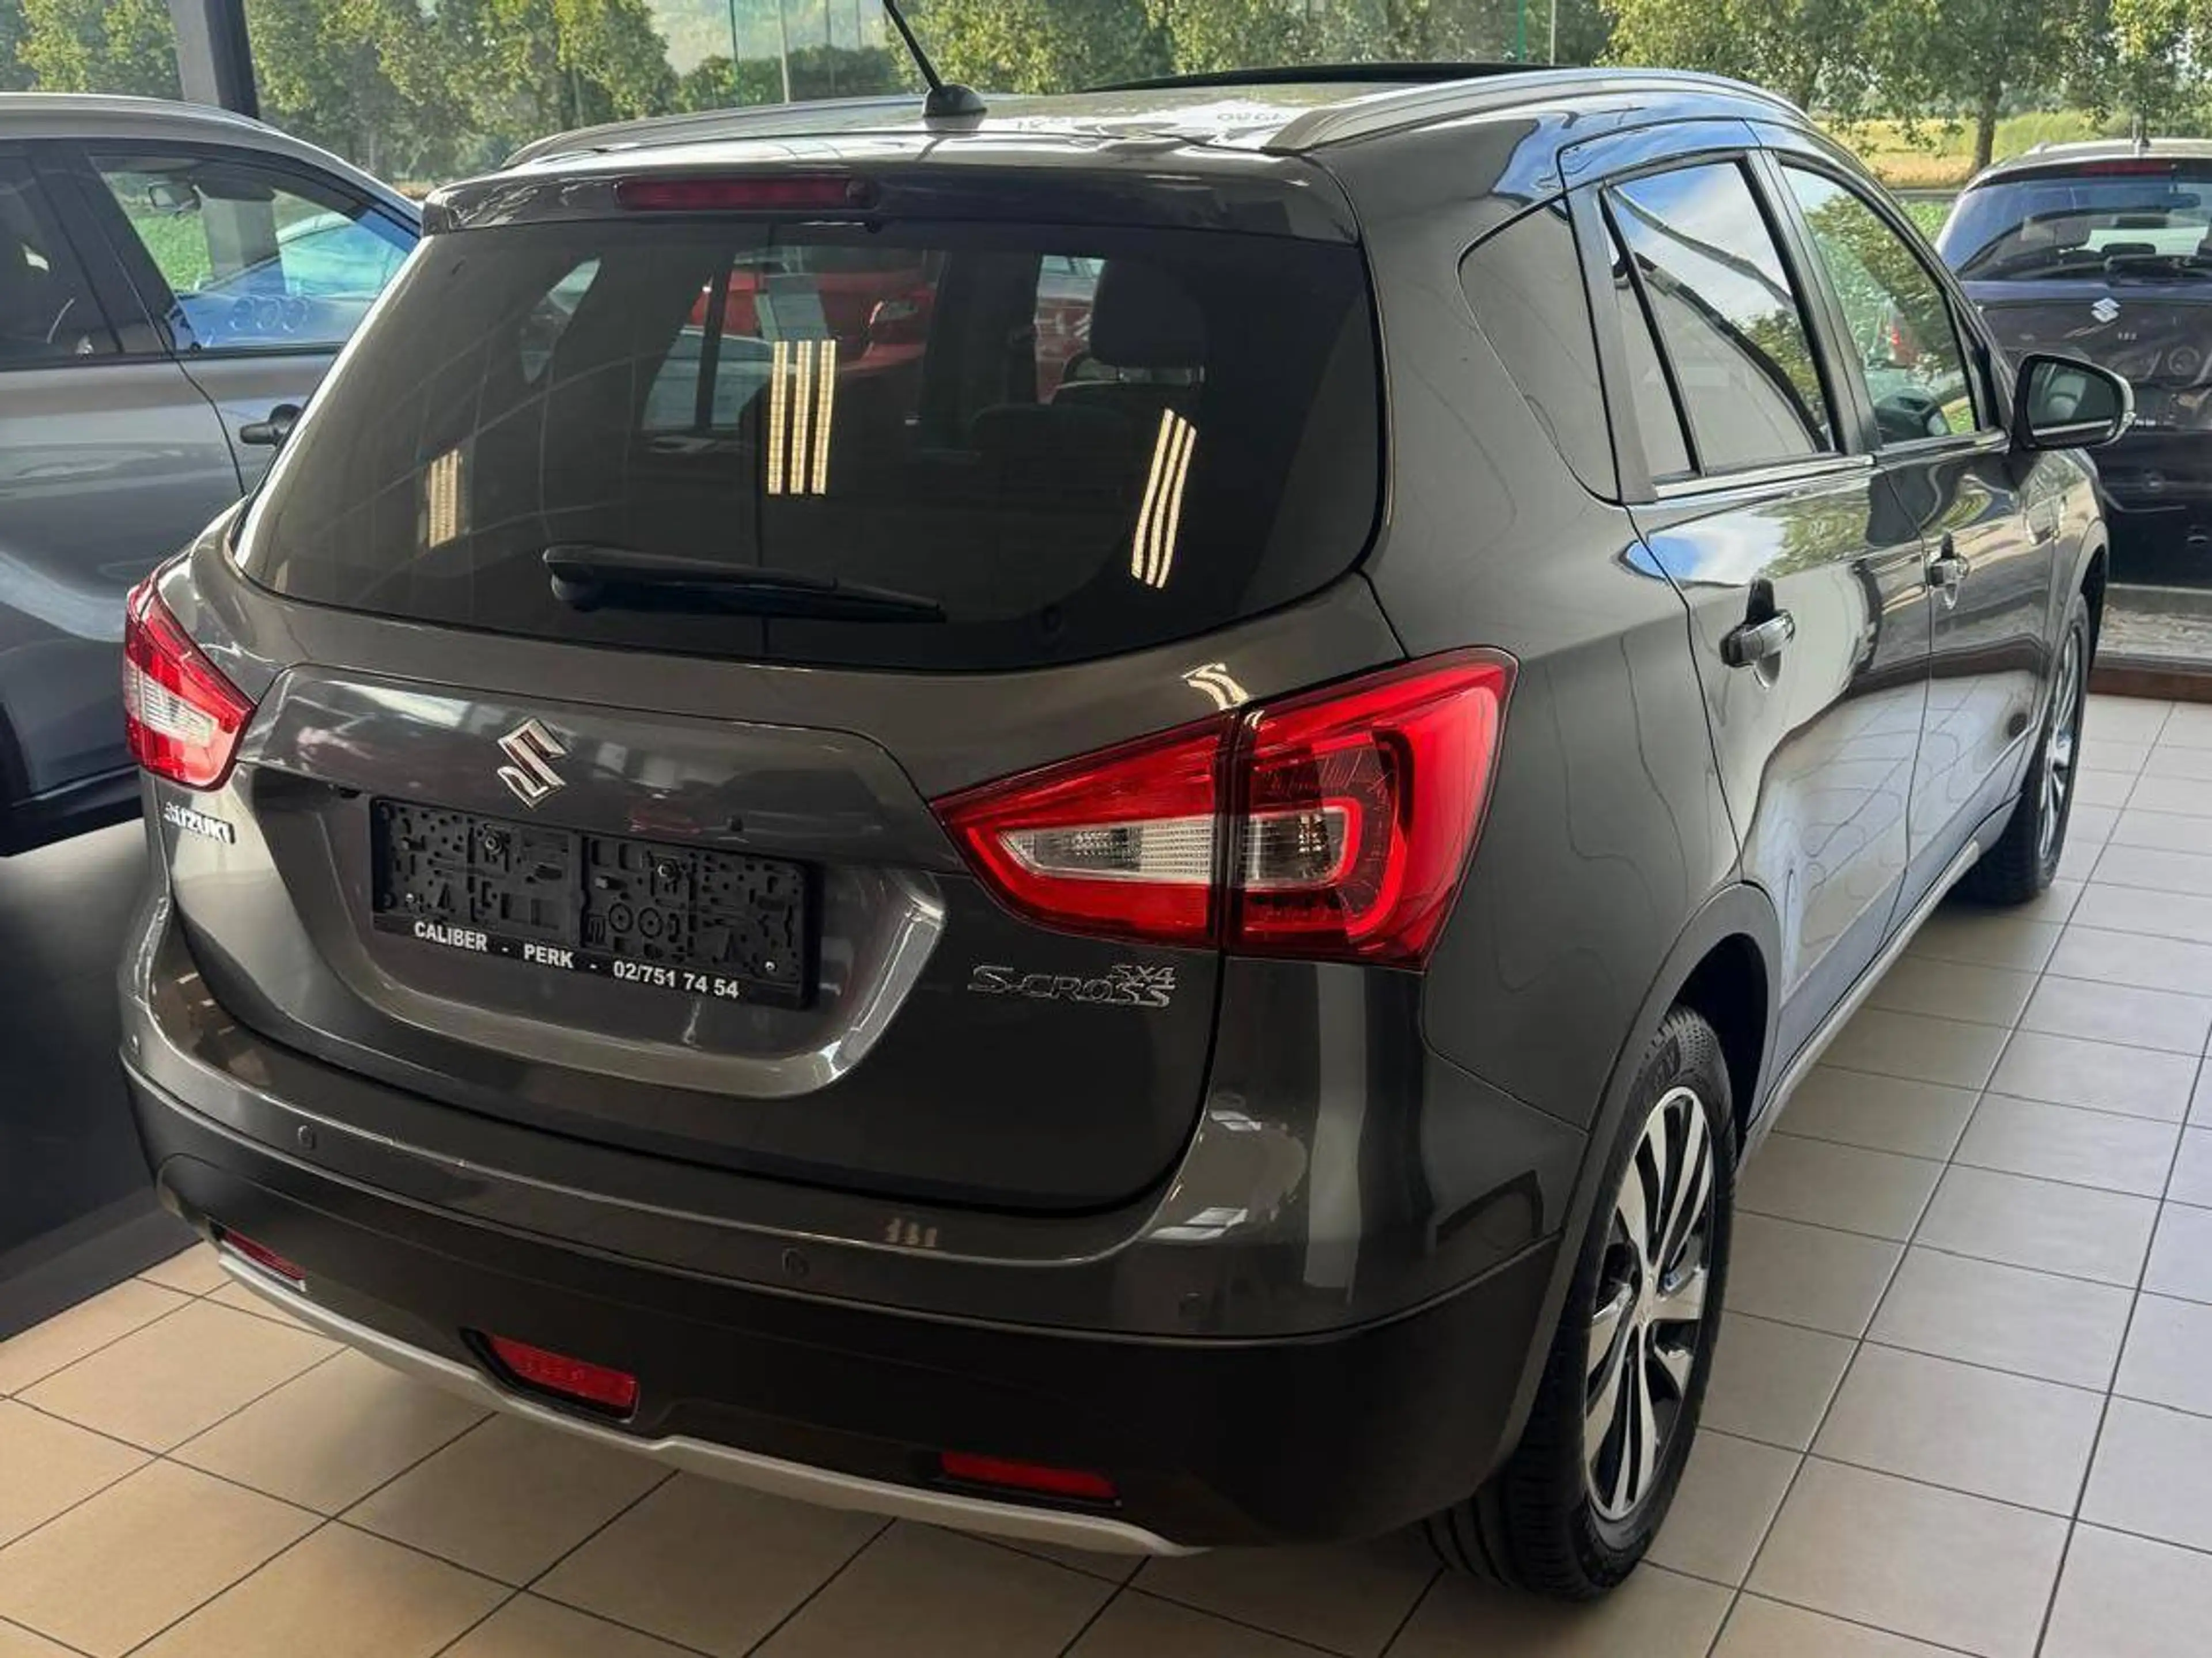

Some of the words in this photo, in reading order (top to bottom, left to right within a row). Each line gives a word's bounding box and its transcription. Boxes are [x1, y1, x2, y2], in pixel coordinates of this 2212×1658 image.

[414, 922, 488, 951] CALIBER
[524, 943, 574, 968] PERK
[613, 960, 676, 987] 02/751
[683, 972, 708, 993] 74
[713, 978, 739, 998] 54
